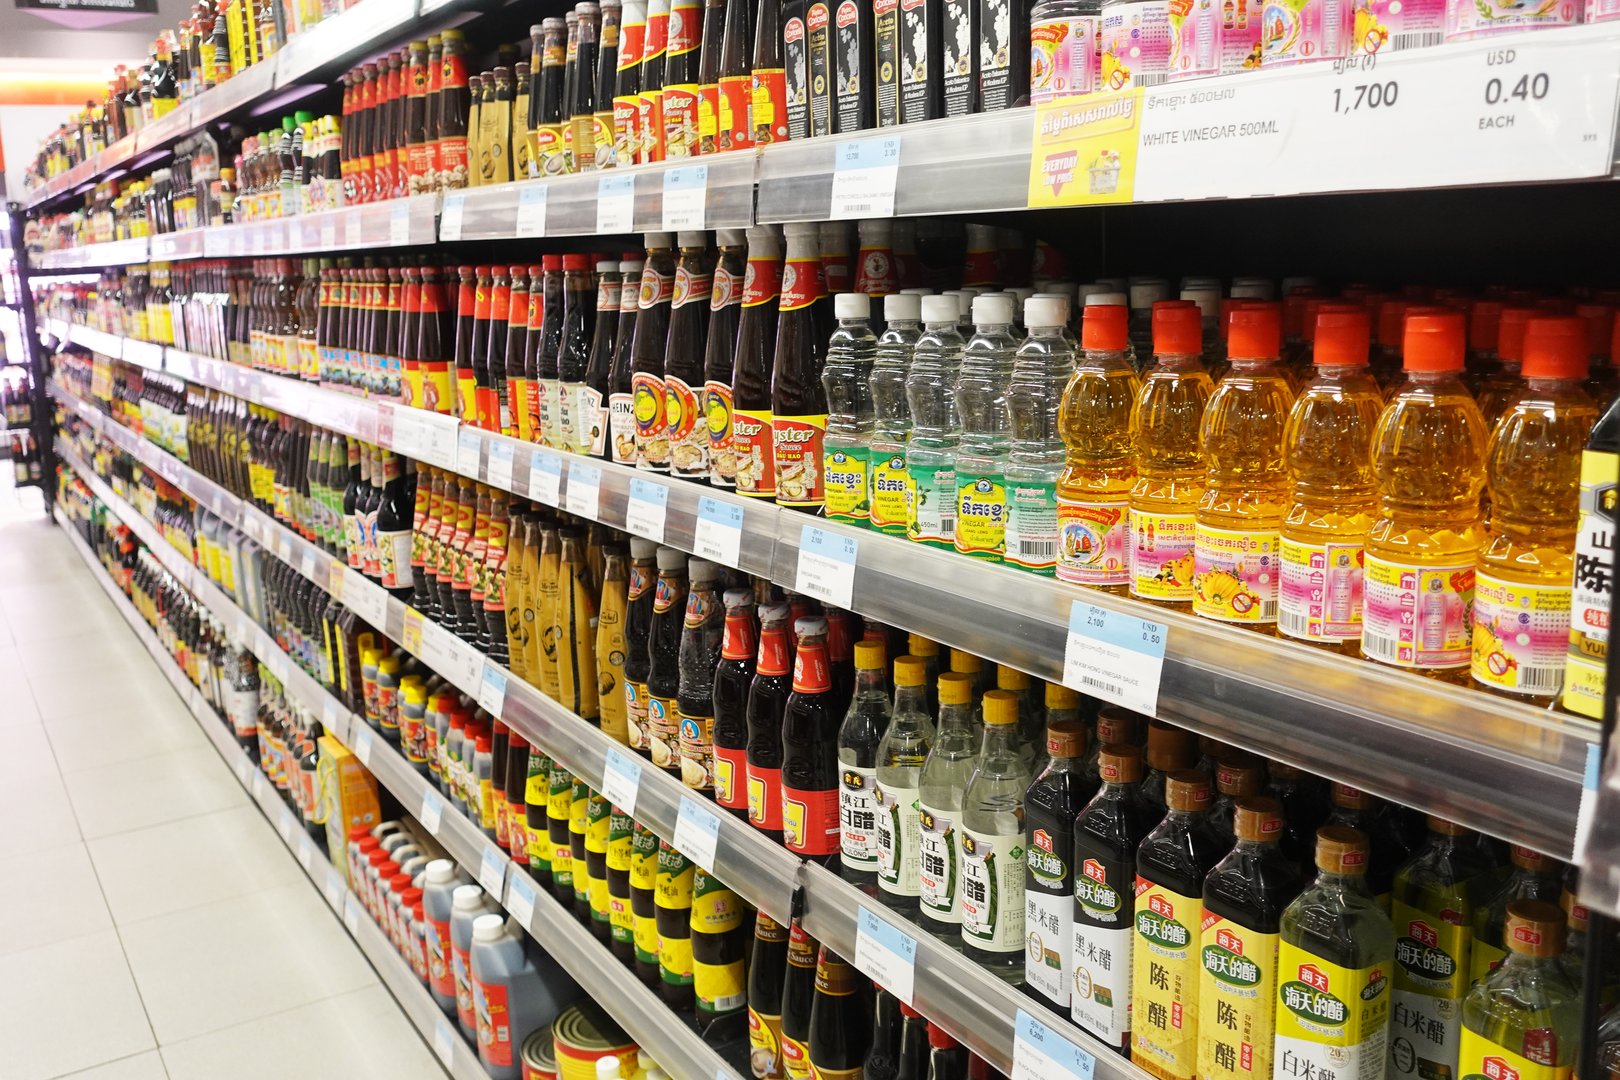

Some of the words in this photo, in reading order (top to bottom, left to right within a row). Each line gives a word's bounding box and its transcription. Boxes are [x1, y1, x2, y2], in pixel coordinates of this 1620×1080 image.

[1487, 50, 1516, 66] USD
[1333, 81, 1398, 114] 1,700
[1485, 72, 1550, 105] 0.40
[1143, 131, 1178, 147] WHITE
[1182, 127, 1236, 143] VINEGAR
[1239, 120, 1279, 136] 500ML
[1478, 115, 1515, 130] EACH
[1041, 155, 1078, 174] EVERYDAY
[1042, 175, 1058, 186] LOW
[1087, 616, 1104, 628] 2,100
[1142, 621, 1157, 633] USD
[1101, 668, 1122, 680] VINEGAR
[1123, 676, 1139, 687] SAUCE
[1035, 833, 1050, 850] 海天
[1027, 849, 1062, 876] 海天的醋
[1086, 865, 1103, 882] 海天
[1076, 880, 1116, 908] 海天的醋
[1028, 899, 1059, 936] 黑米醋
[1151, 899, 1171, 917] 海天
[755, 927, 777, 938] Sauce
[1139, 914, 1186, 945] 海天的醋
[1411, 924, 1435, 945] 海天
[1075, 932, 1112, 971] 黑米醋
[1219, 934, 1240, 953] 海天
[791, 953, 814, 963] Sauce
[1206, 950, 1257, 983] 海天的醋
[1397, 943, 1452, 975] 海天的醋
[1301, 968, 1326, 991] 海天
[1148, 961, 1169, 1030] 陈醋
[1285, 985, 1345, 1022] 海天的醋
[1394, 1002, 1445, 1046] 白米醋
[1215, 999, 1238, 1072] 陈醋
[1075, 1049, 1087, 1061] USD
